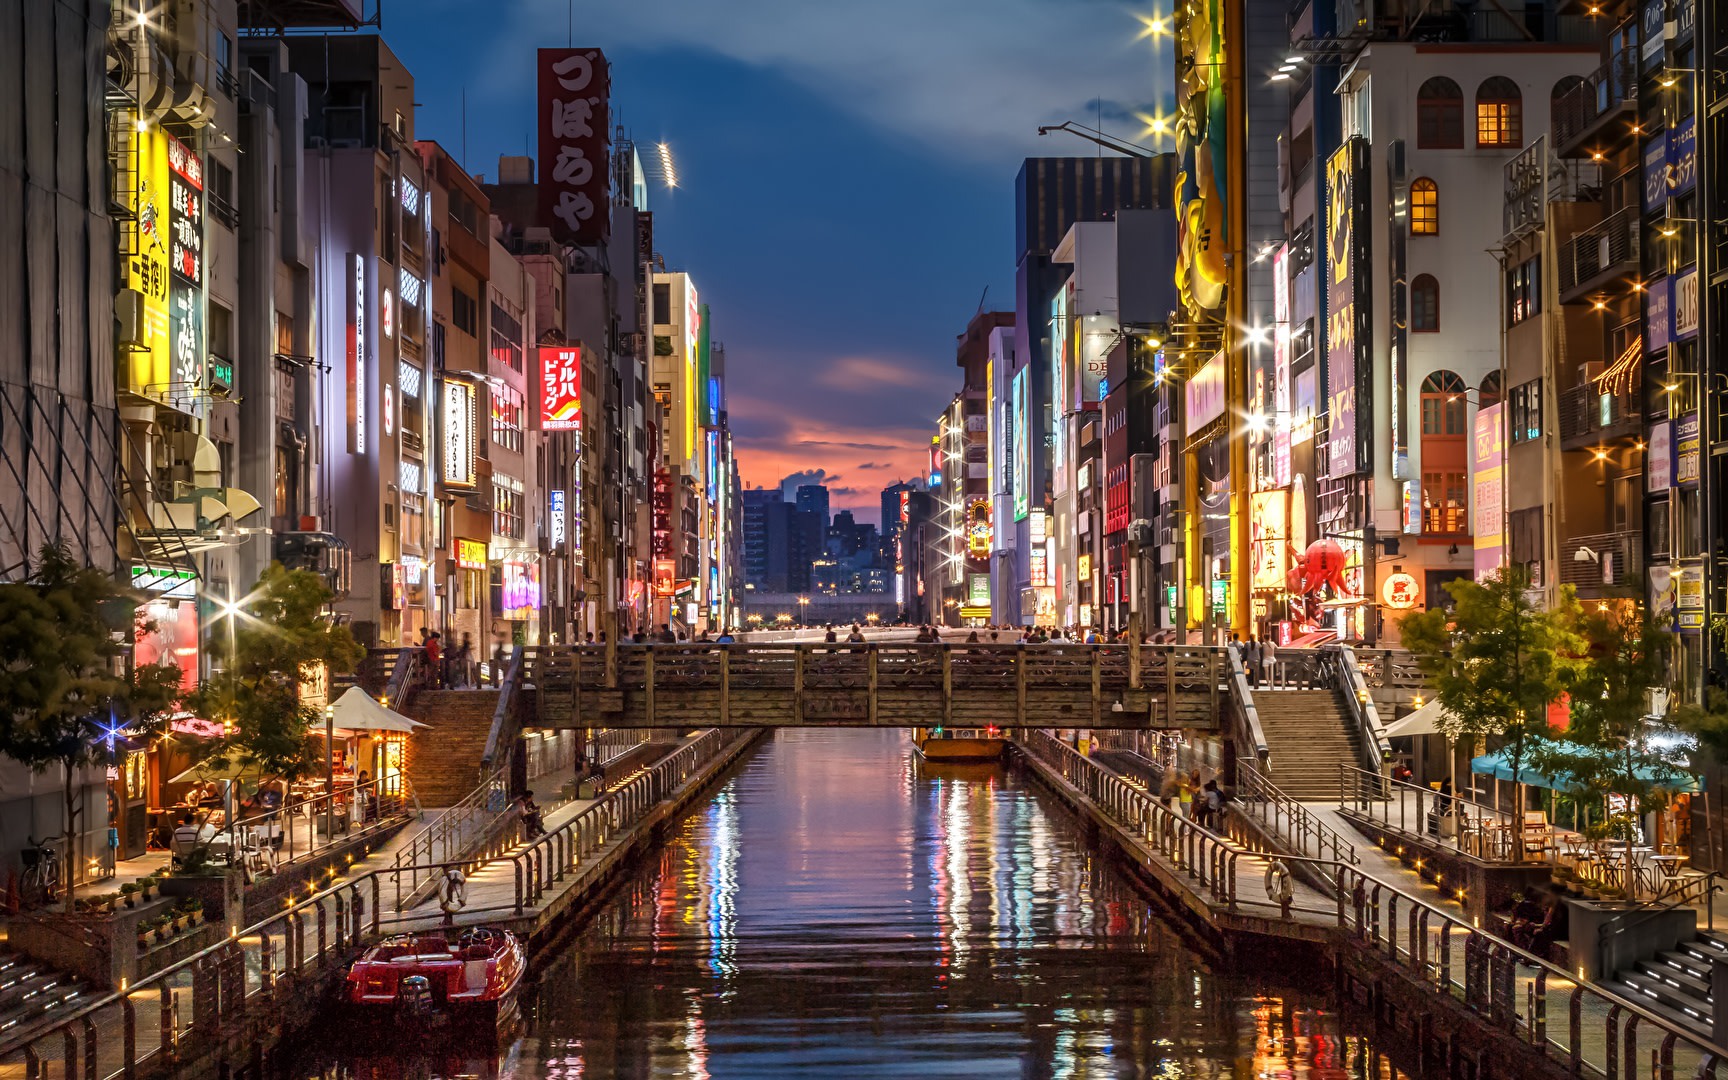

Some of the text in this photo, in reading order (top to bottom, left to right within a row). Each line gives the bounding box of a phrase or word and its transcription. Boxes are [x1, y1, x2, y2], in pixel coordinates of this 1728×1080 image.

[552, 51, 599, 232] づぼらや
[544, 360, 559, 410] ドラッグ
[559, 352, 577, 398] ツルハ
[553, 493, 563, 511] 焼肉
[1265, 526, 1276, 574] 松阪牛
